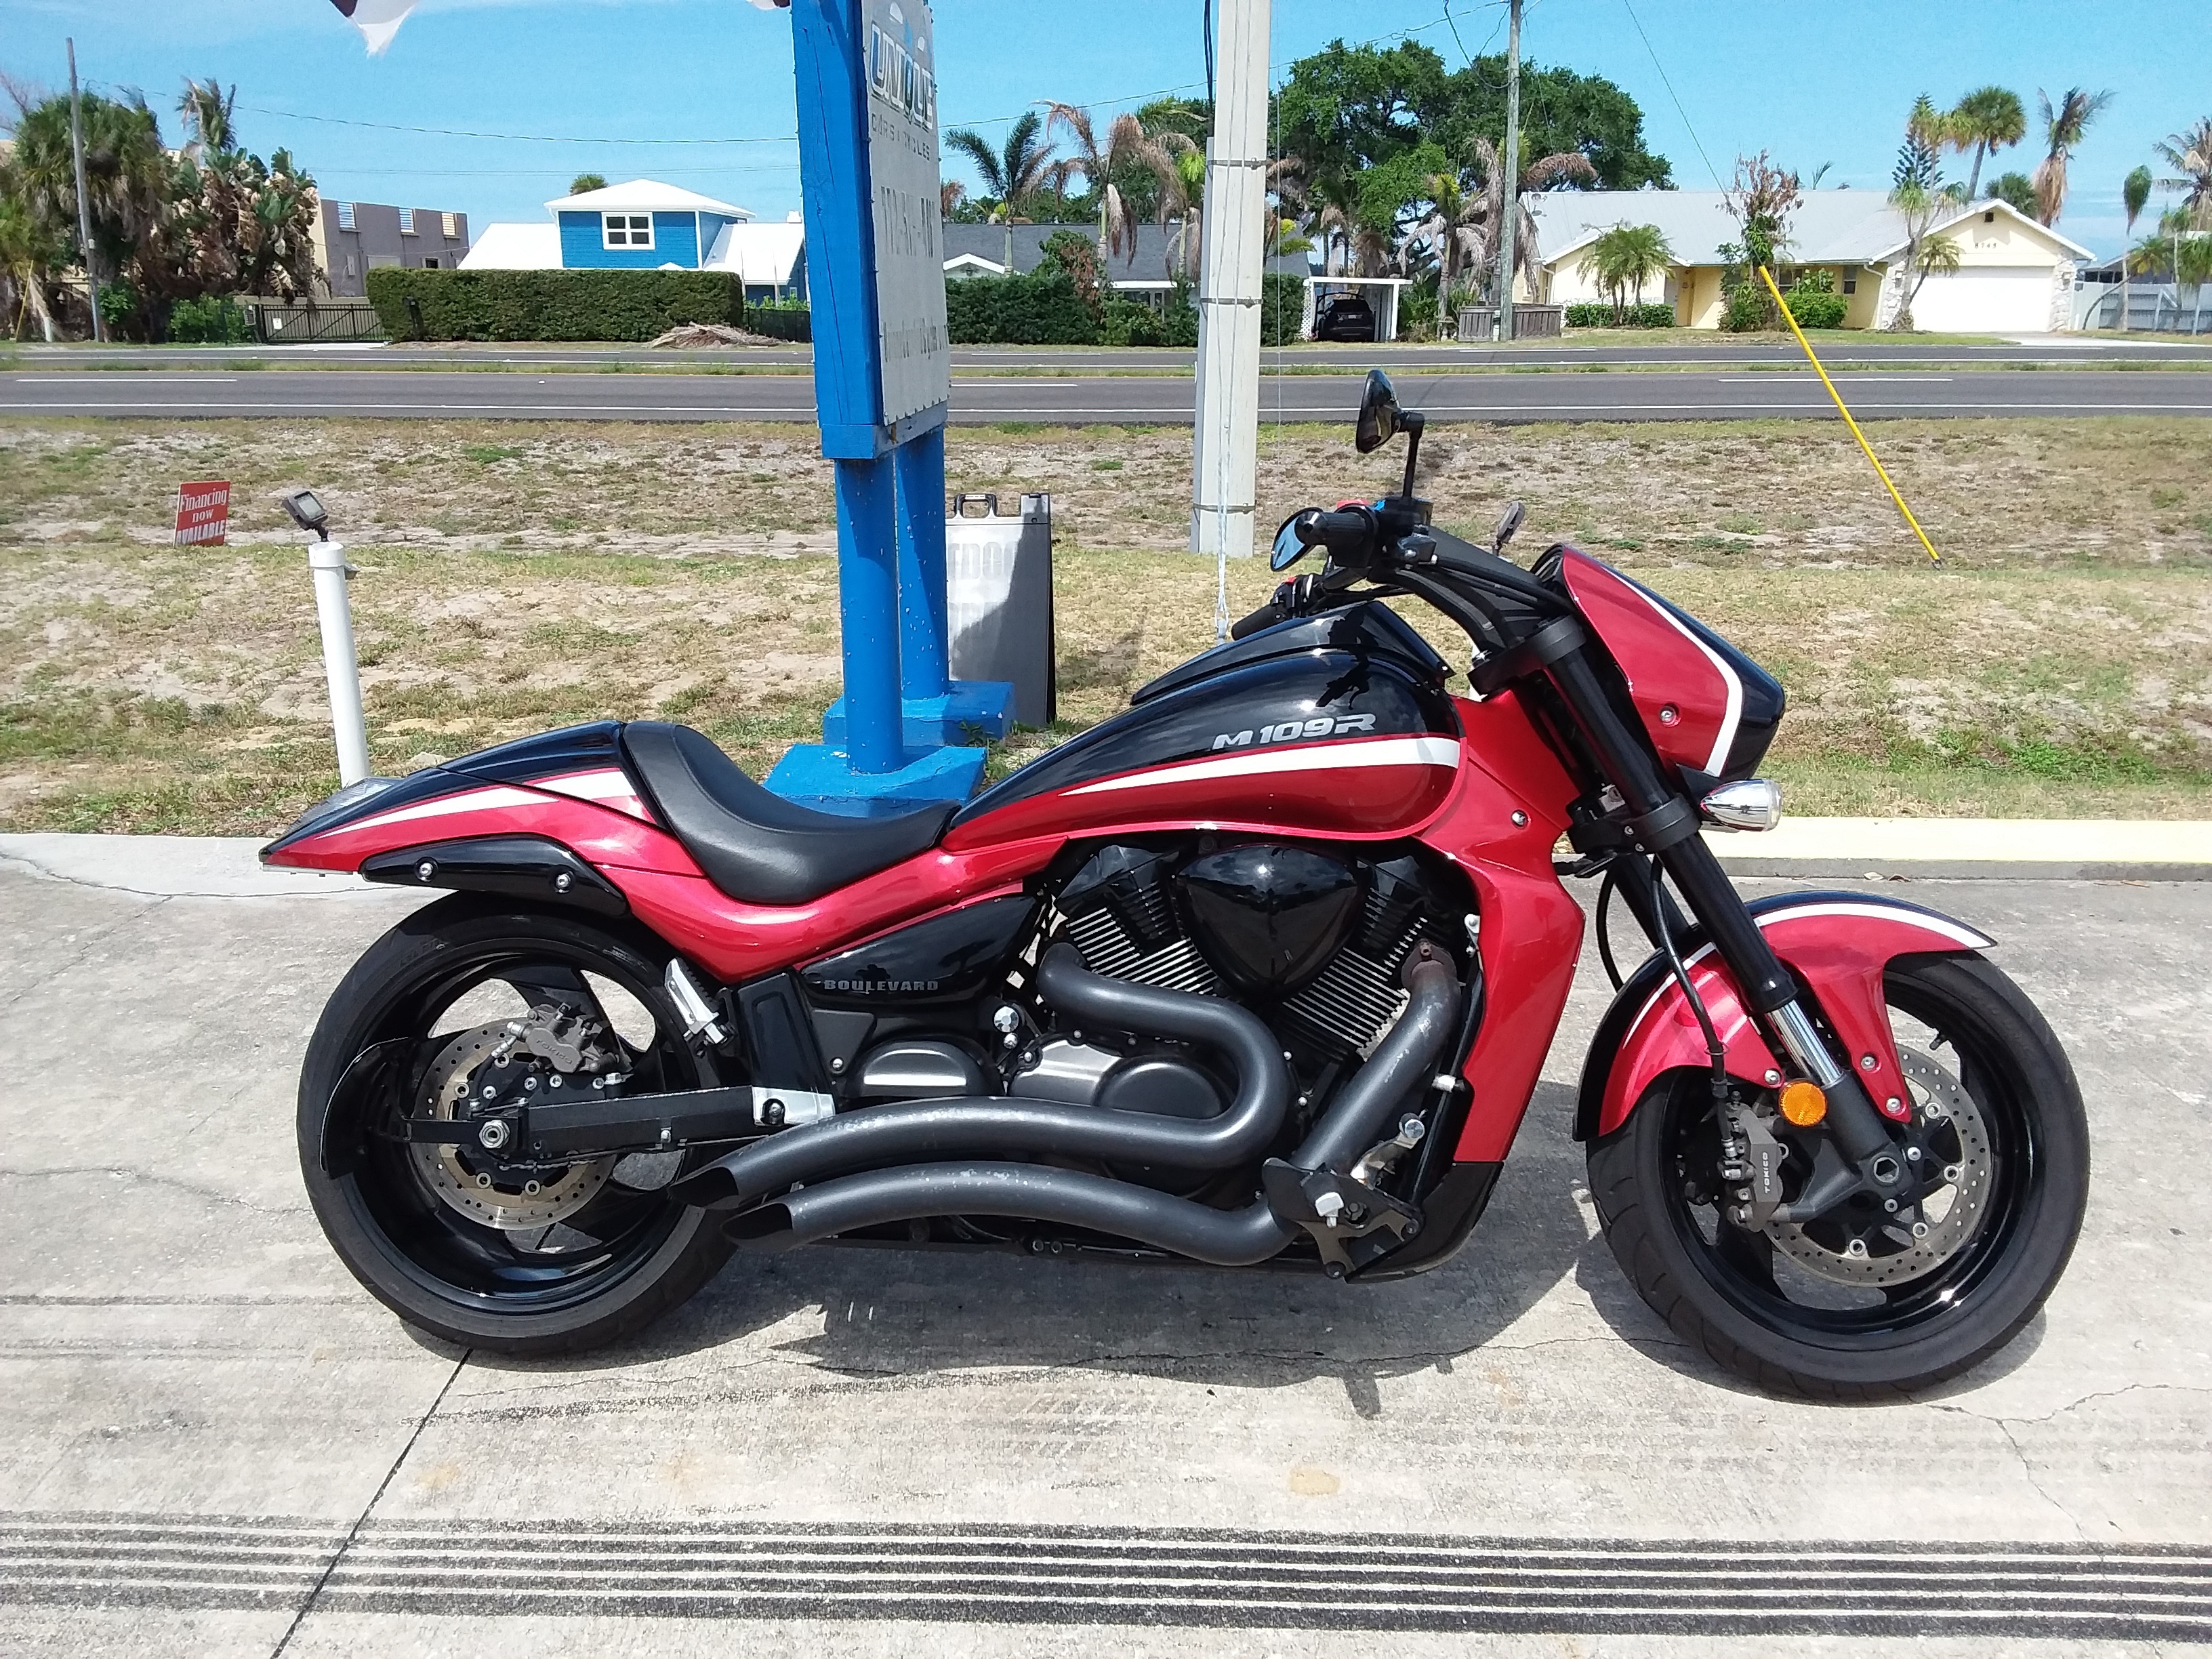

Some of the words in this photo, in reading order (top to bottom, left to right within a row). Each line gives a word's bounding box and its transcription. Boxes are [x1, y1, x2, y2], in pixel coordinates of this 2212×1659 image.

[869, 21, 933, 131] UNIQUE
[872, 112, 895, 141] CARS
[179, 488, 227, 513] Financing
[192, 509, 214, 523] now
[176, 520, 226, 545] AVAILABLE
[823, 979, 939, 991] BOULEVARD
[1762, 1151, 1771, 1194] TOKICO
